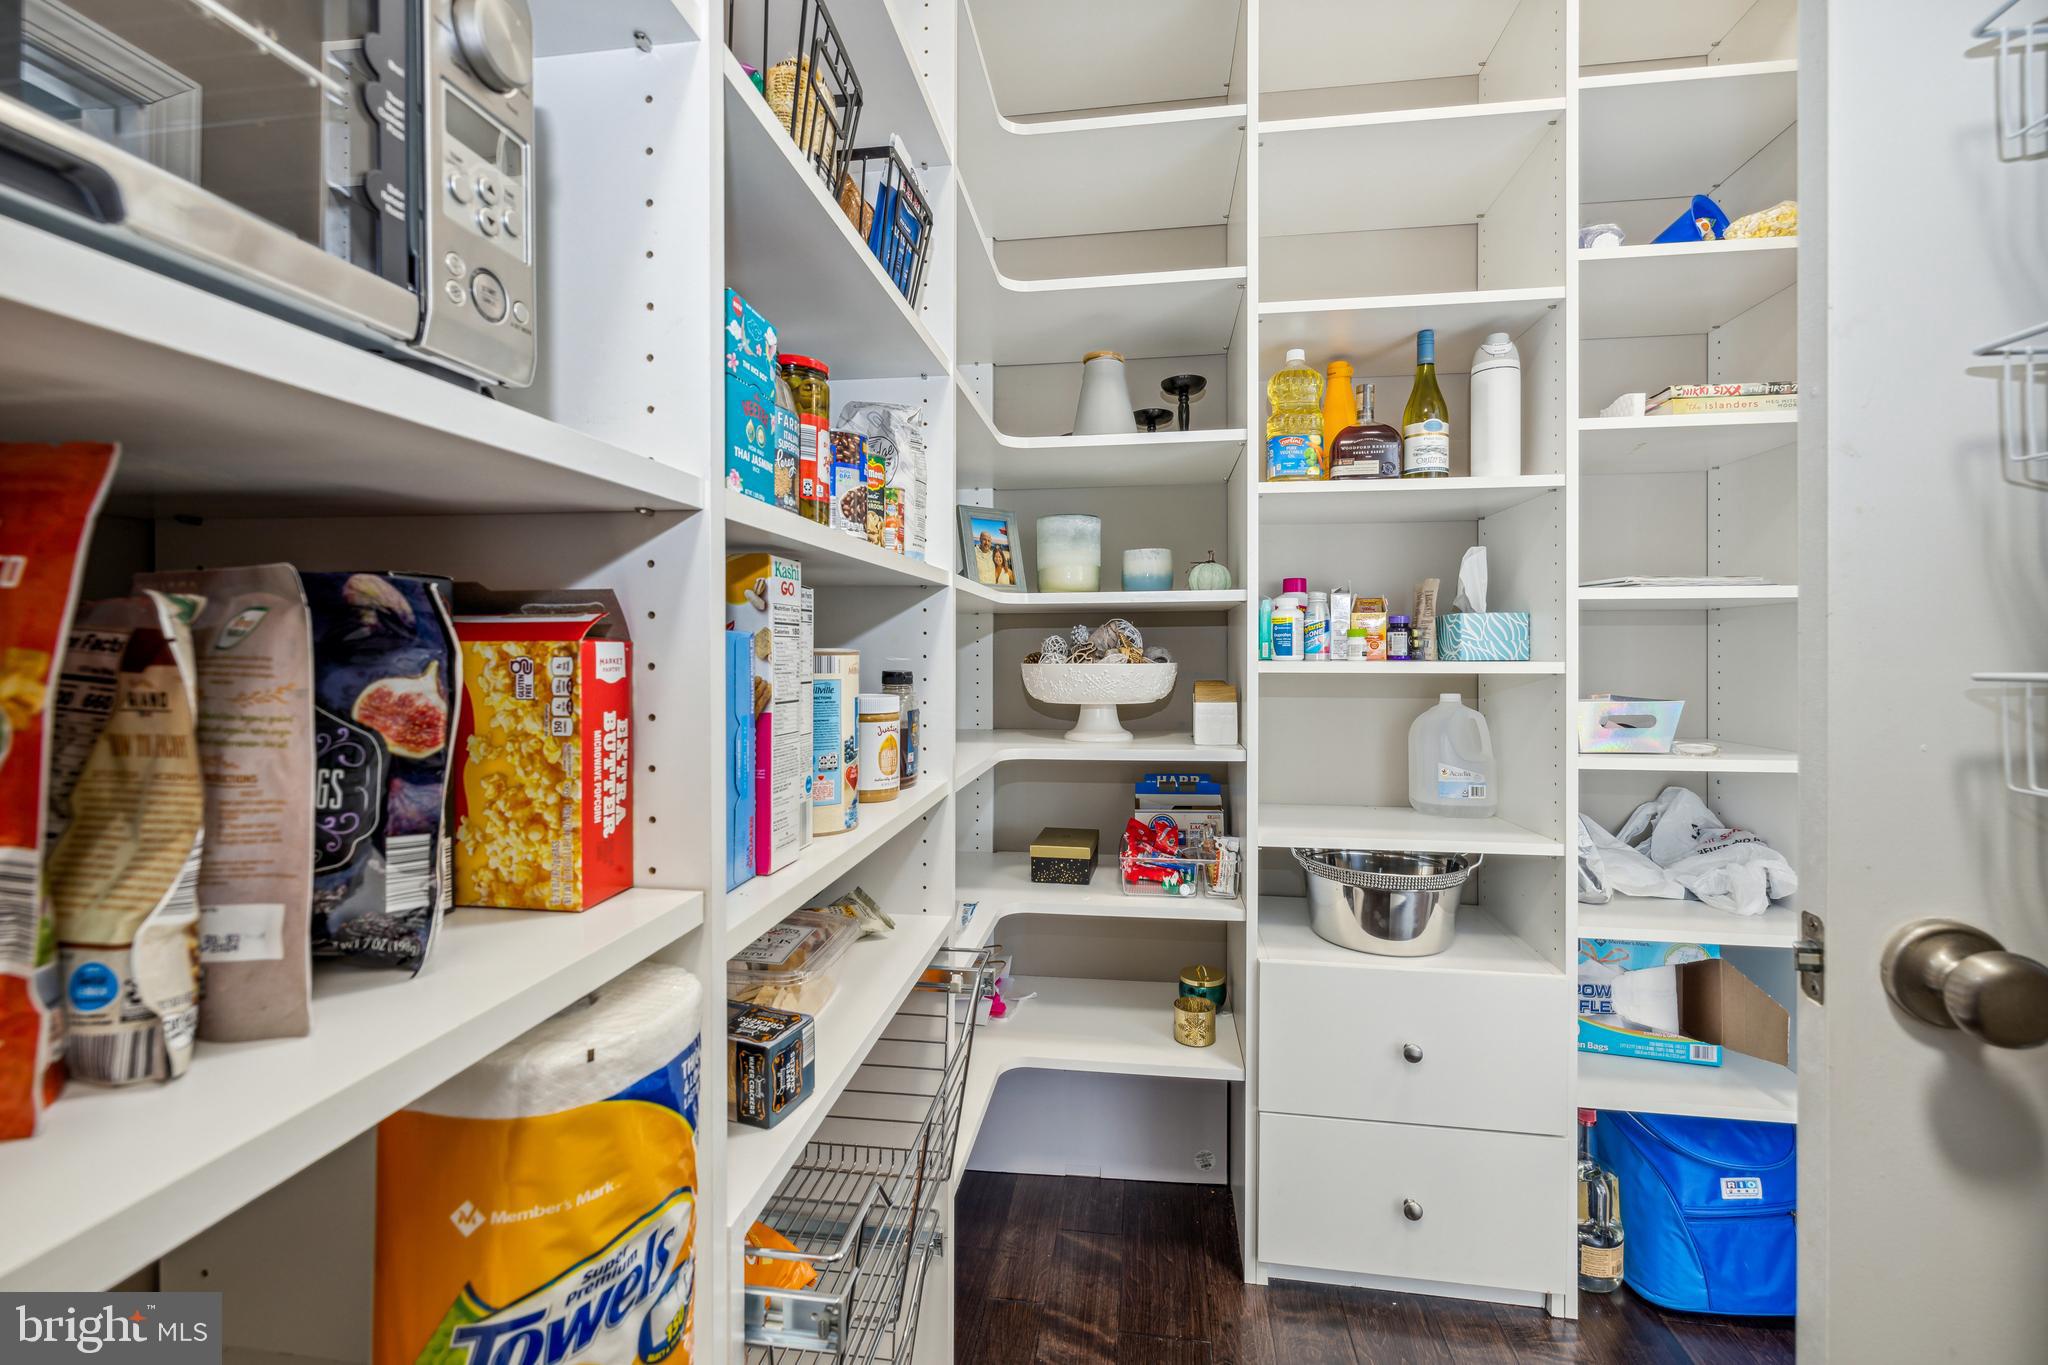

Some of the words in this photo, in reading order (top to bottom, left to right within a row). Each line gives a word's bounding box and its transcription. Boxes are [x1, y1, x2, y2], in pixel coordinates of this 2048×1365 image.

[1682, 386, 1708, 397] NIKKI
[1713, 385, 1742, 396] SIXX
[1705, 401, 1759, 410] islanders
[734, 445, 750, 462] THAI
[774, 561, 800, 581] Kashi
[781, 581, 795, 596] GO
[600, 657, 623, 667] MARKET
[517, 673, 525, 699] GLUTEN
[813, 686, 835, 694] illville
[553, 720, 562, 733] 150
[593, 730, 602, 780] MICROWAVE
[603, 710, 617, 838] BUTTER
[615, 718, 628, 826] EXTRA
[316, 768, 345, 810] GS
[593, 782, 602, 824] POPCORN
[1580, 1000, 1616, 1015] FLE
[1587, 1042, 1609, 1052] Bags
[490, 1202, 573, 1226] Member's
[575, 1181, 615, 1207] Mark
[581, 1244, 629, 1285] Super
[565, 1249, 639, 1308] Premium
[450, 1225, 676, 1365] Towels
